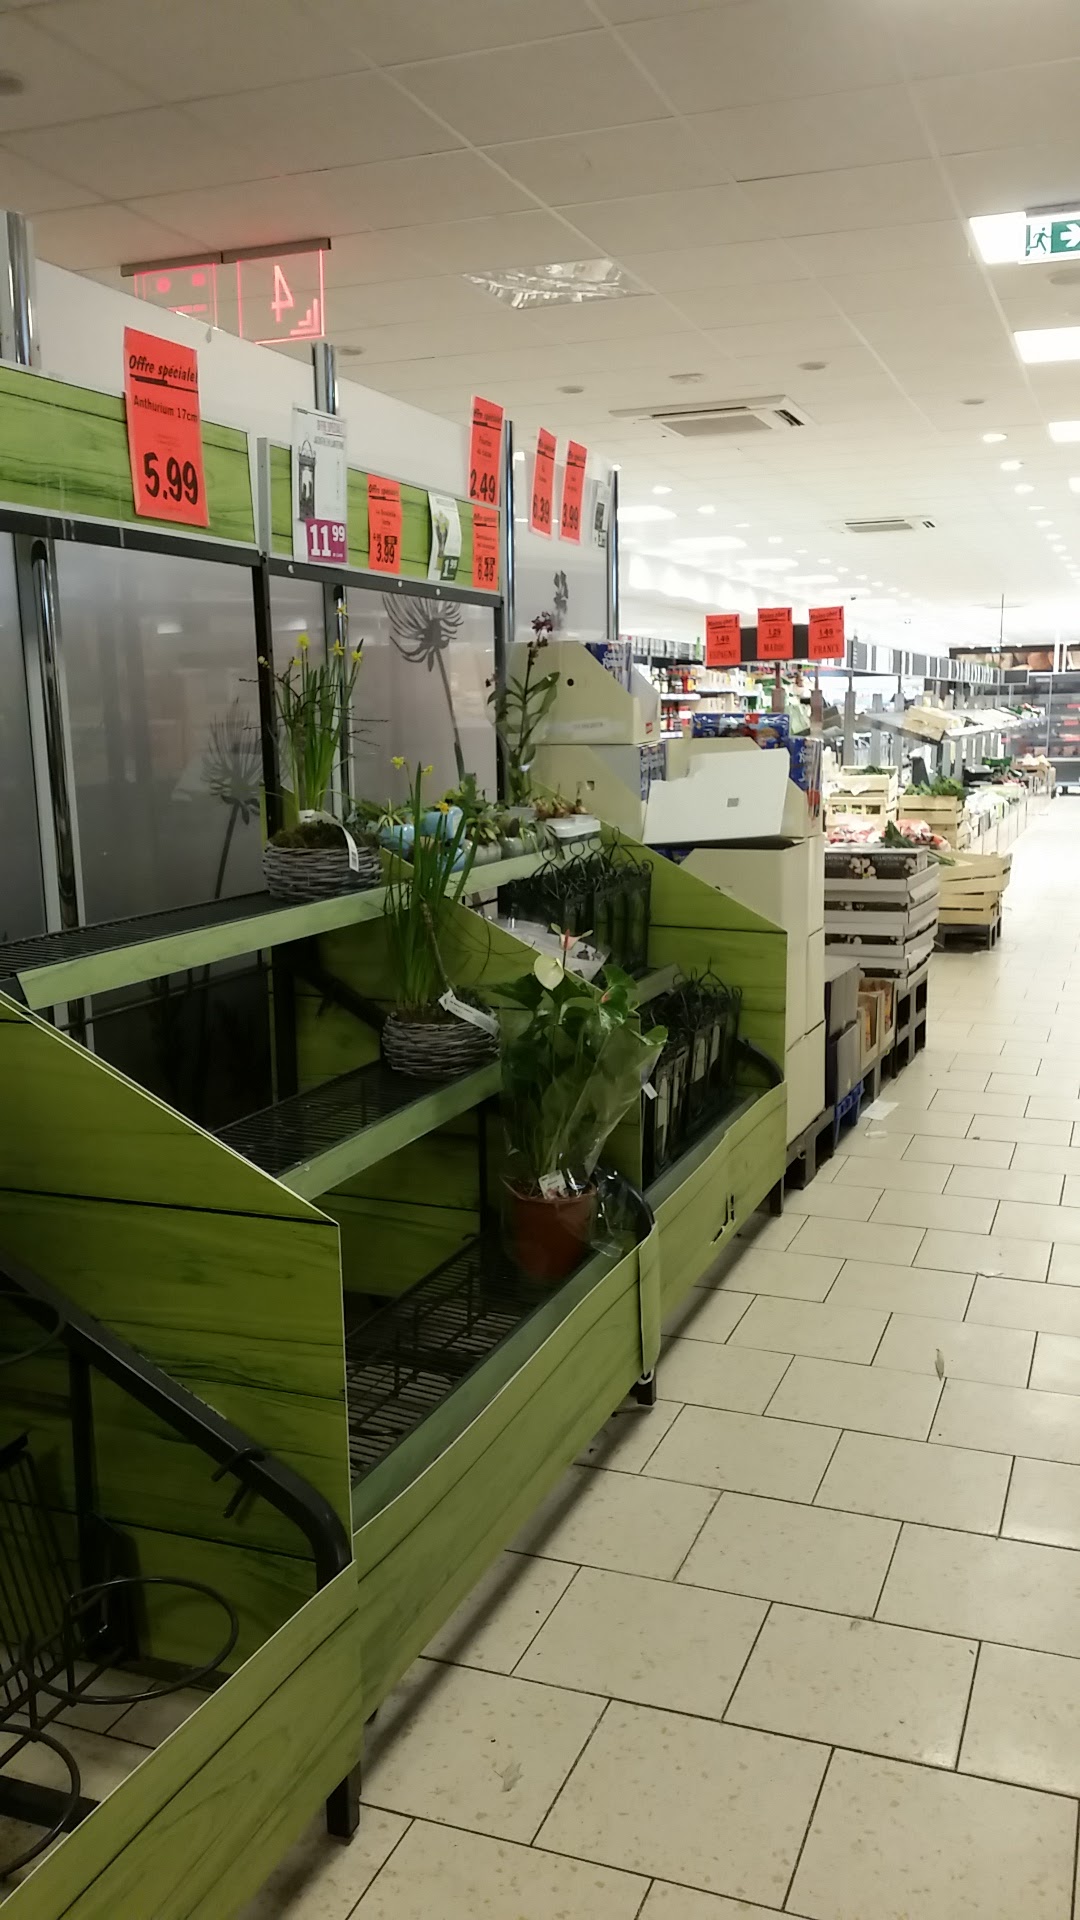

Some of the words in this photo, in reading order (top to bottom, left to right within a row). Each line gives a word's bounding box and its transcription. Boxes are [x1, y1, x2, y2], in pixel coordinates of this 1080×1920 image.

[129, 355, 155, 374] Offre
[133, 395, 175, 417] Anthurium
[177, 408, 198, 423] 17cm
[144, 451, 198, 506] 5.99
[470, 469, 496, 503] 2.49
[376, 541, 395, 565] 3.99
